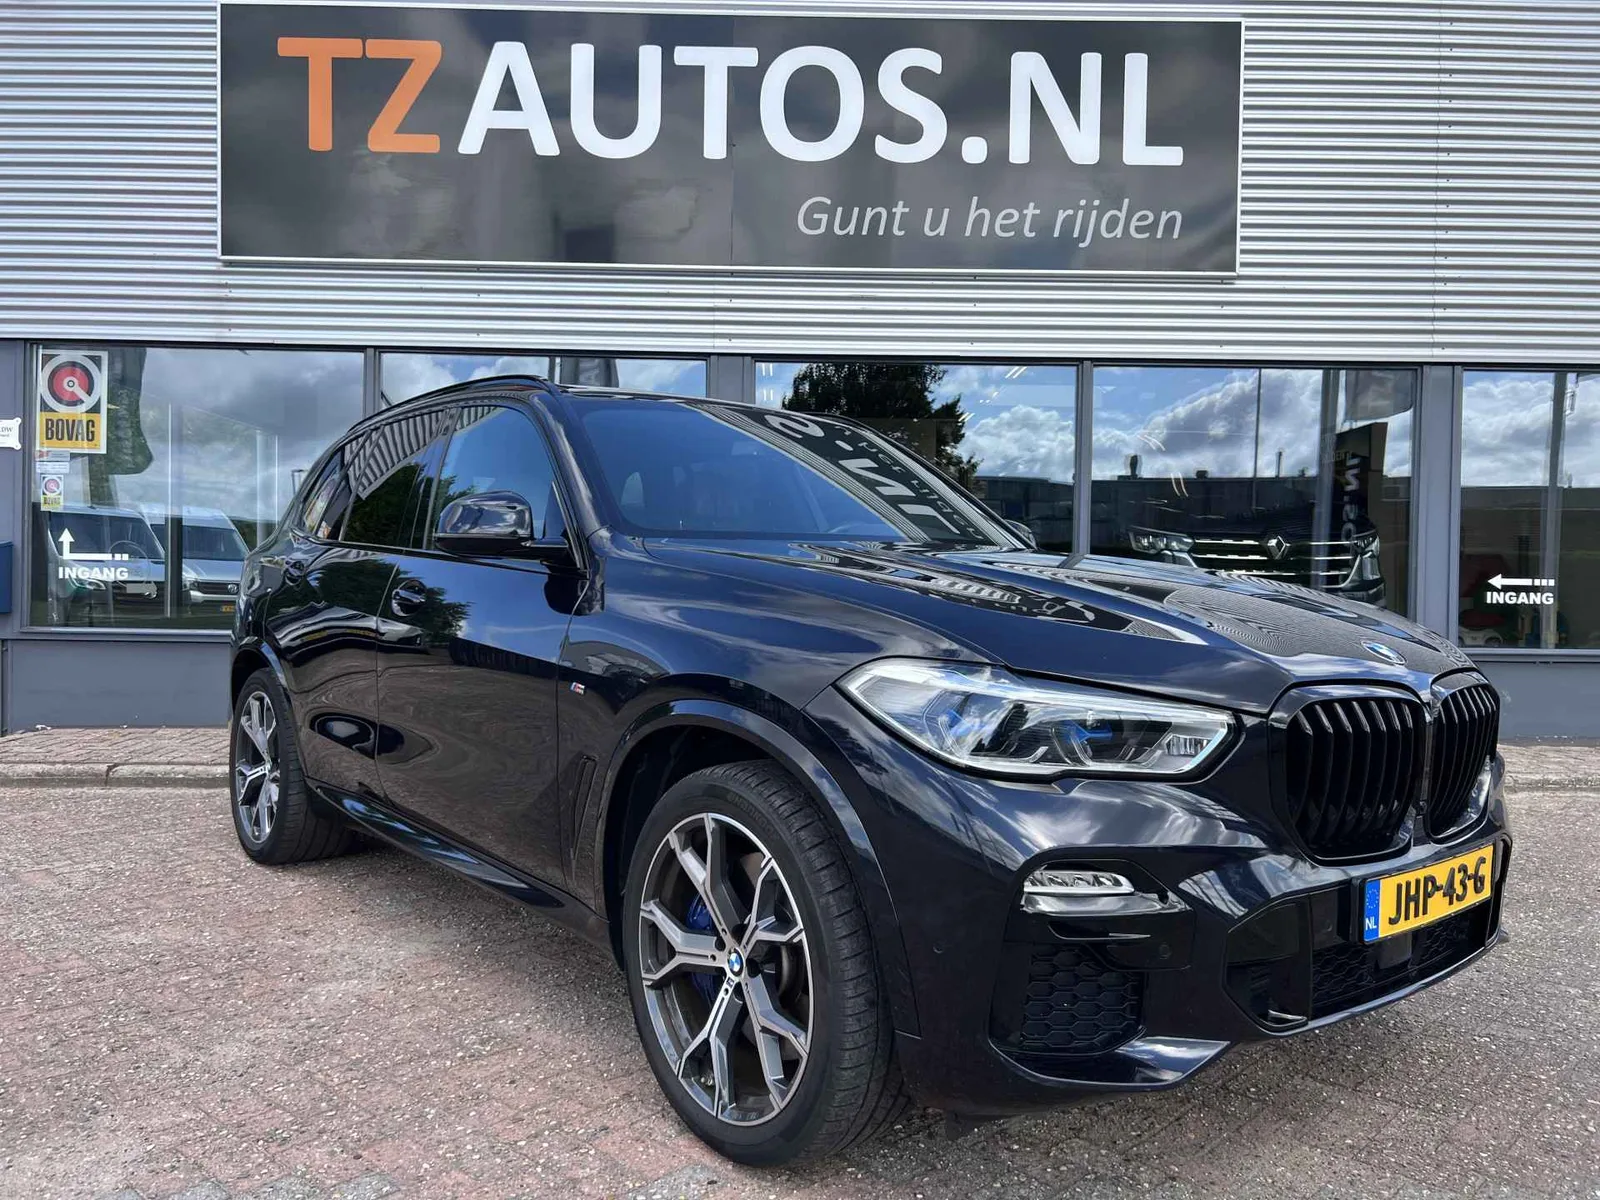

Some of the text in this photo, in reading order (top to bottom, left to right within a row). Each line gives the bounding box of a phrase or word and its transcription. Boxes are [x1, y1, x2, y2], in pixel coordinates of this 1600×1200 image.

[276, 37, 1184, 167] TZAUTOS.NL
[797, 196, 1183, 248] Gunt u het rijden
[45, 418, 95, 442] BOVAG
[58, 566, 129, 581] INGANG
[1486, 591, 1554, 605] INGANG
[1365, 917, 1377, 930] NL
